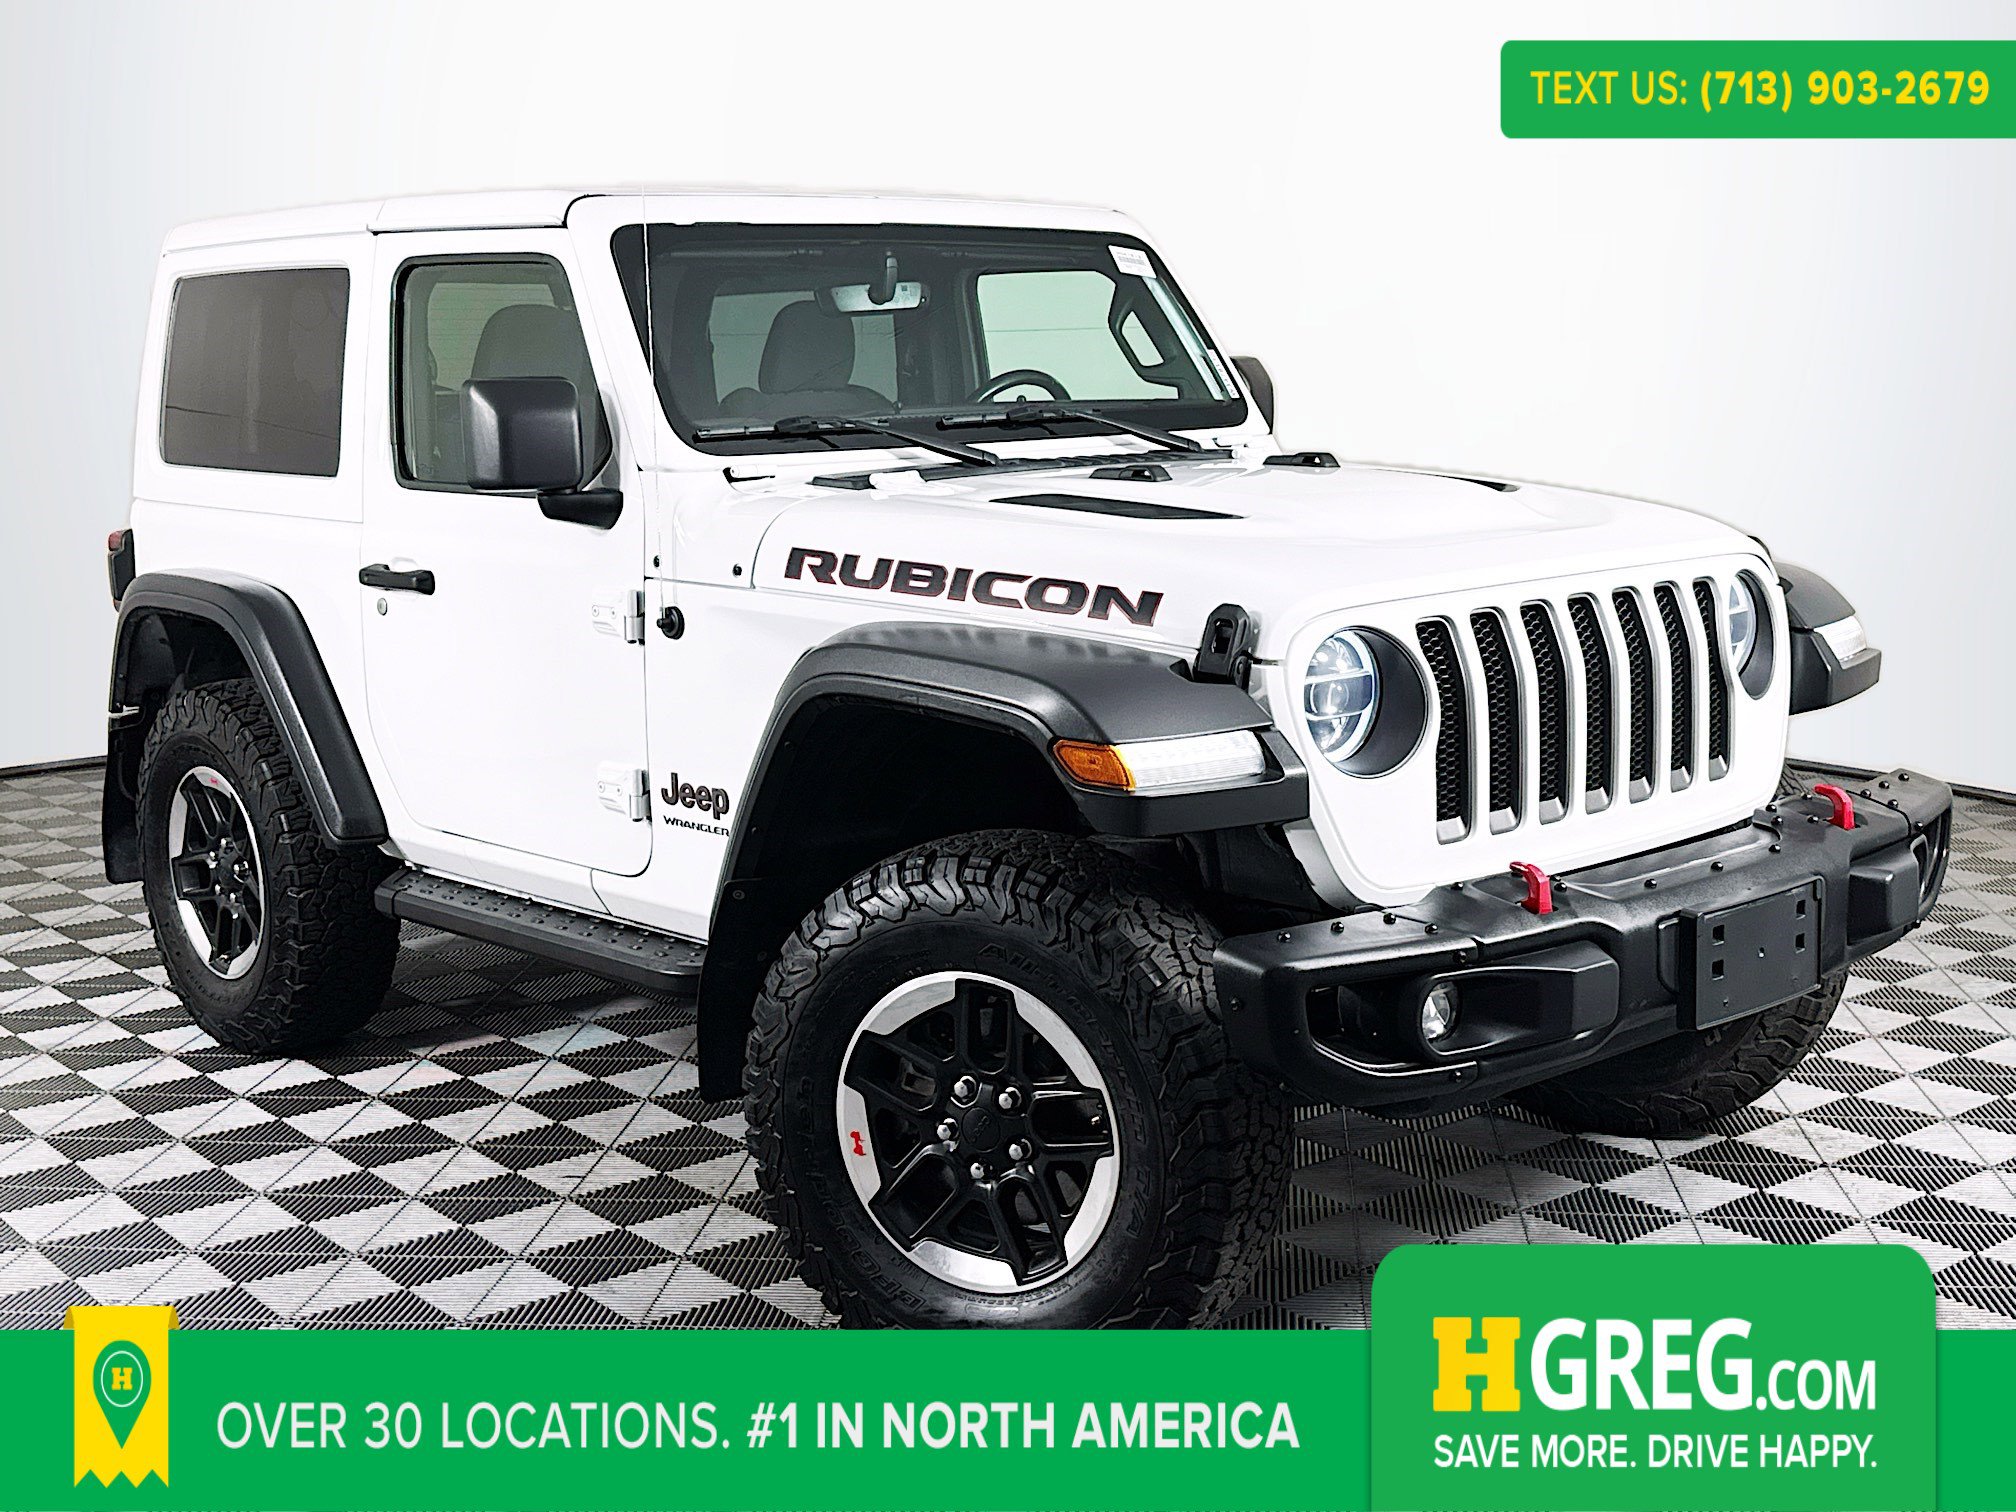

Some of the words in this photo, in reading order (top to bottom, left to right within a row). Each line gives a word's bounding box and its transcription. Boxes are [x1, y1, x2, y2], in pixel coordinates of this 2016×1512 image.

[784, 547, 1164, 626] RUBICON
[661, 772, 729, 820] Jeep
[663, 815, 729, 836] WRANGLER
